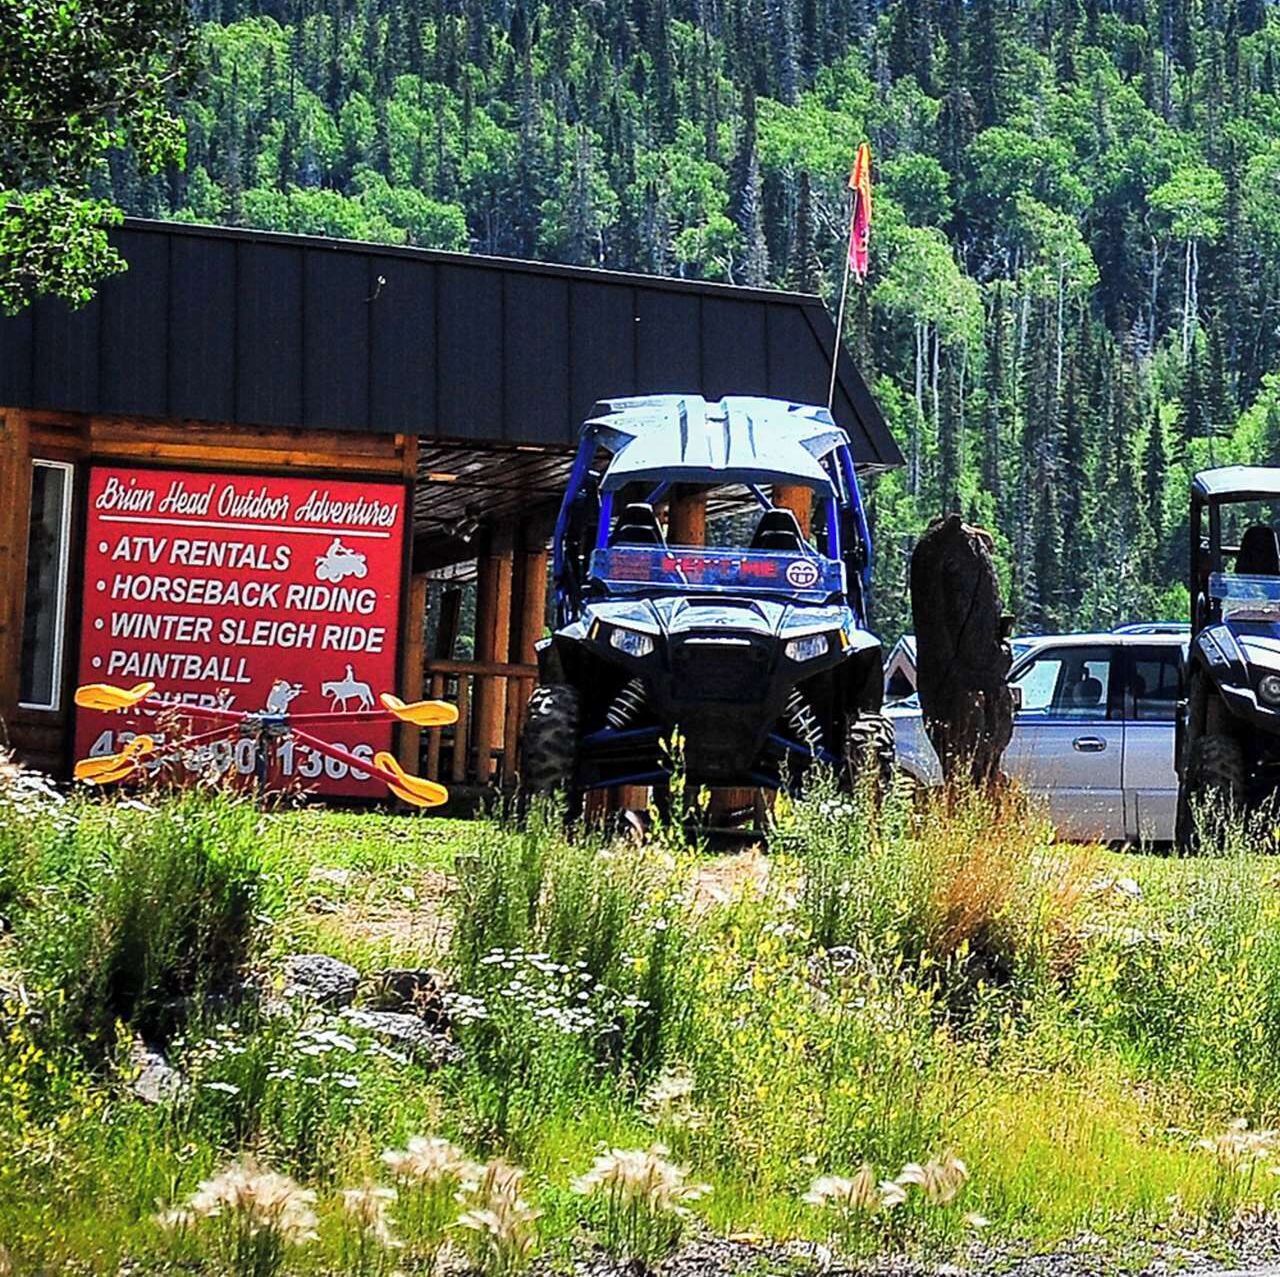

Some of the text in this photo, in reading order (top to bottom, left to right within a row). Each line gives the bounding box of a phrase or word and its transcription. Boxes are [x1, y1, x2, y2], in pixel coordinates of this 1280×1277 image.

[96, 478, 398, 527] Brian Head Outdoor Adventures
[111, 535, 292, 571] ATV RENTALS
[111, 575, 377, 614] HORSEBACK RIDING
[110, 612, 386, 653] WINTER SLEIGH RIDE
[107, 650, 252, 683] PAINTBALL
